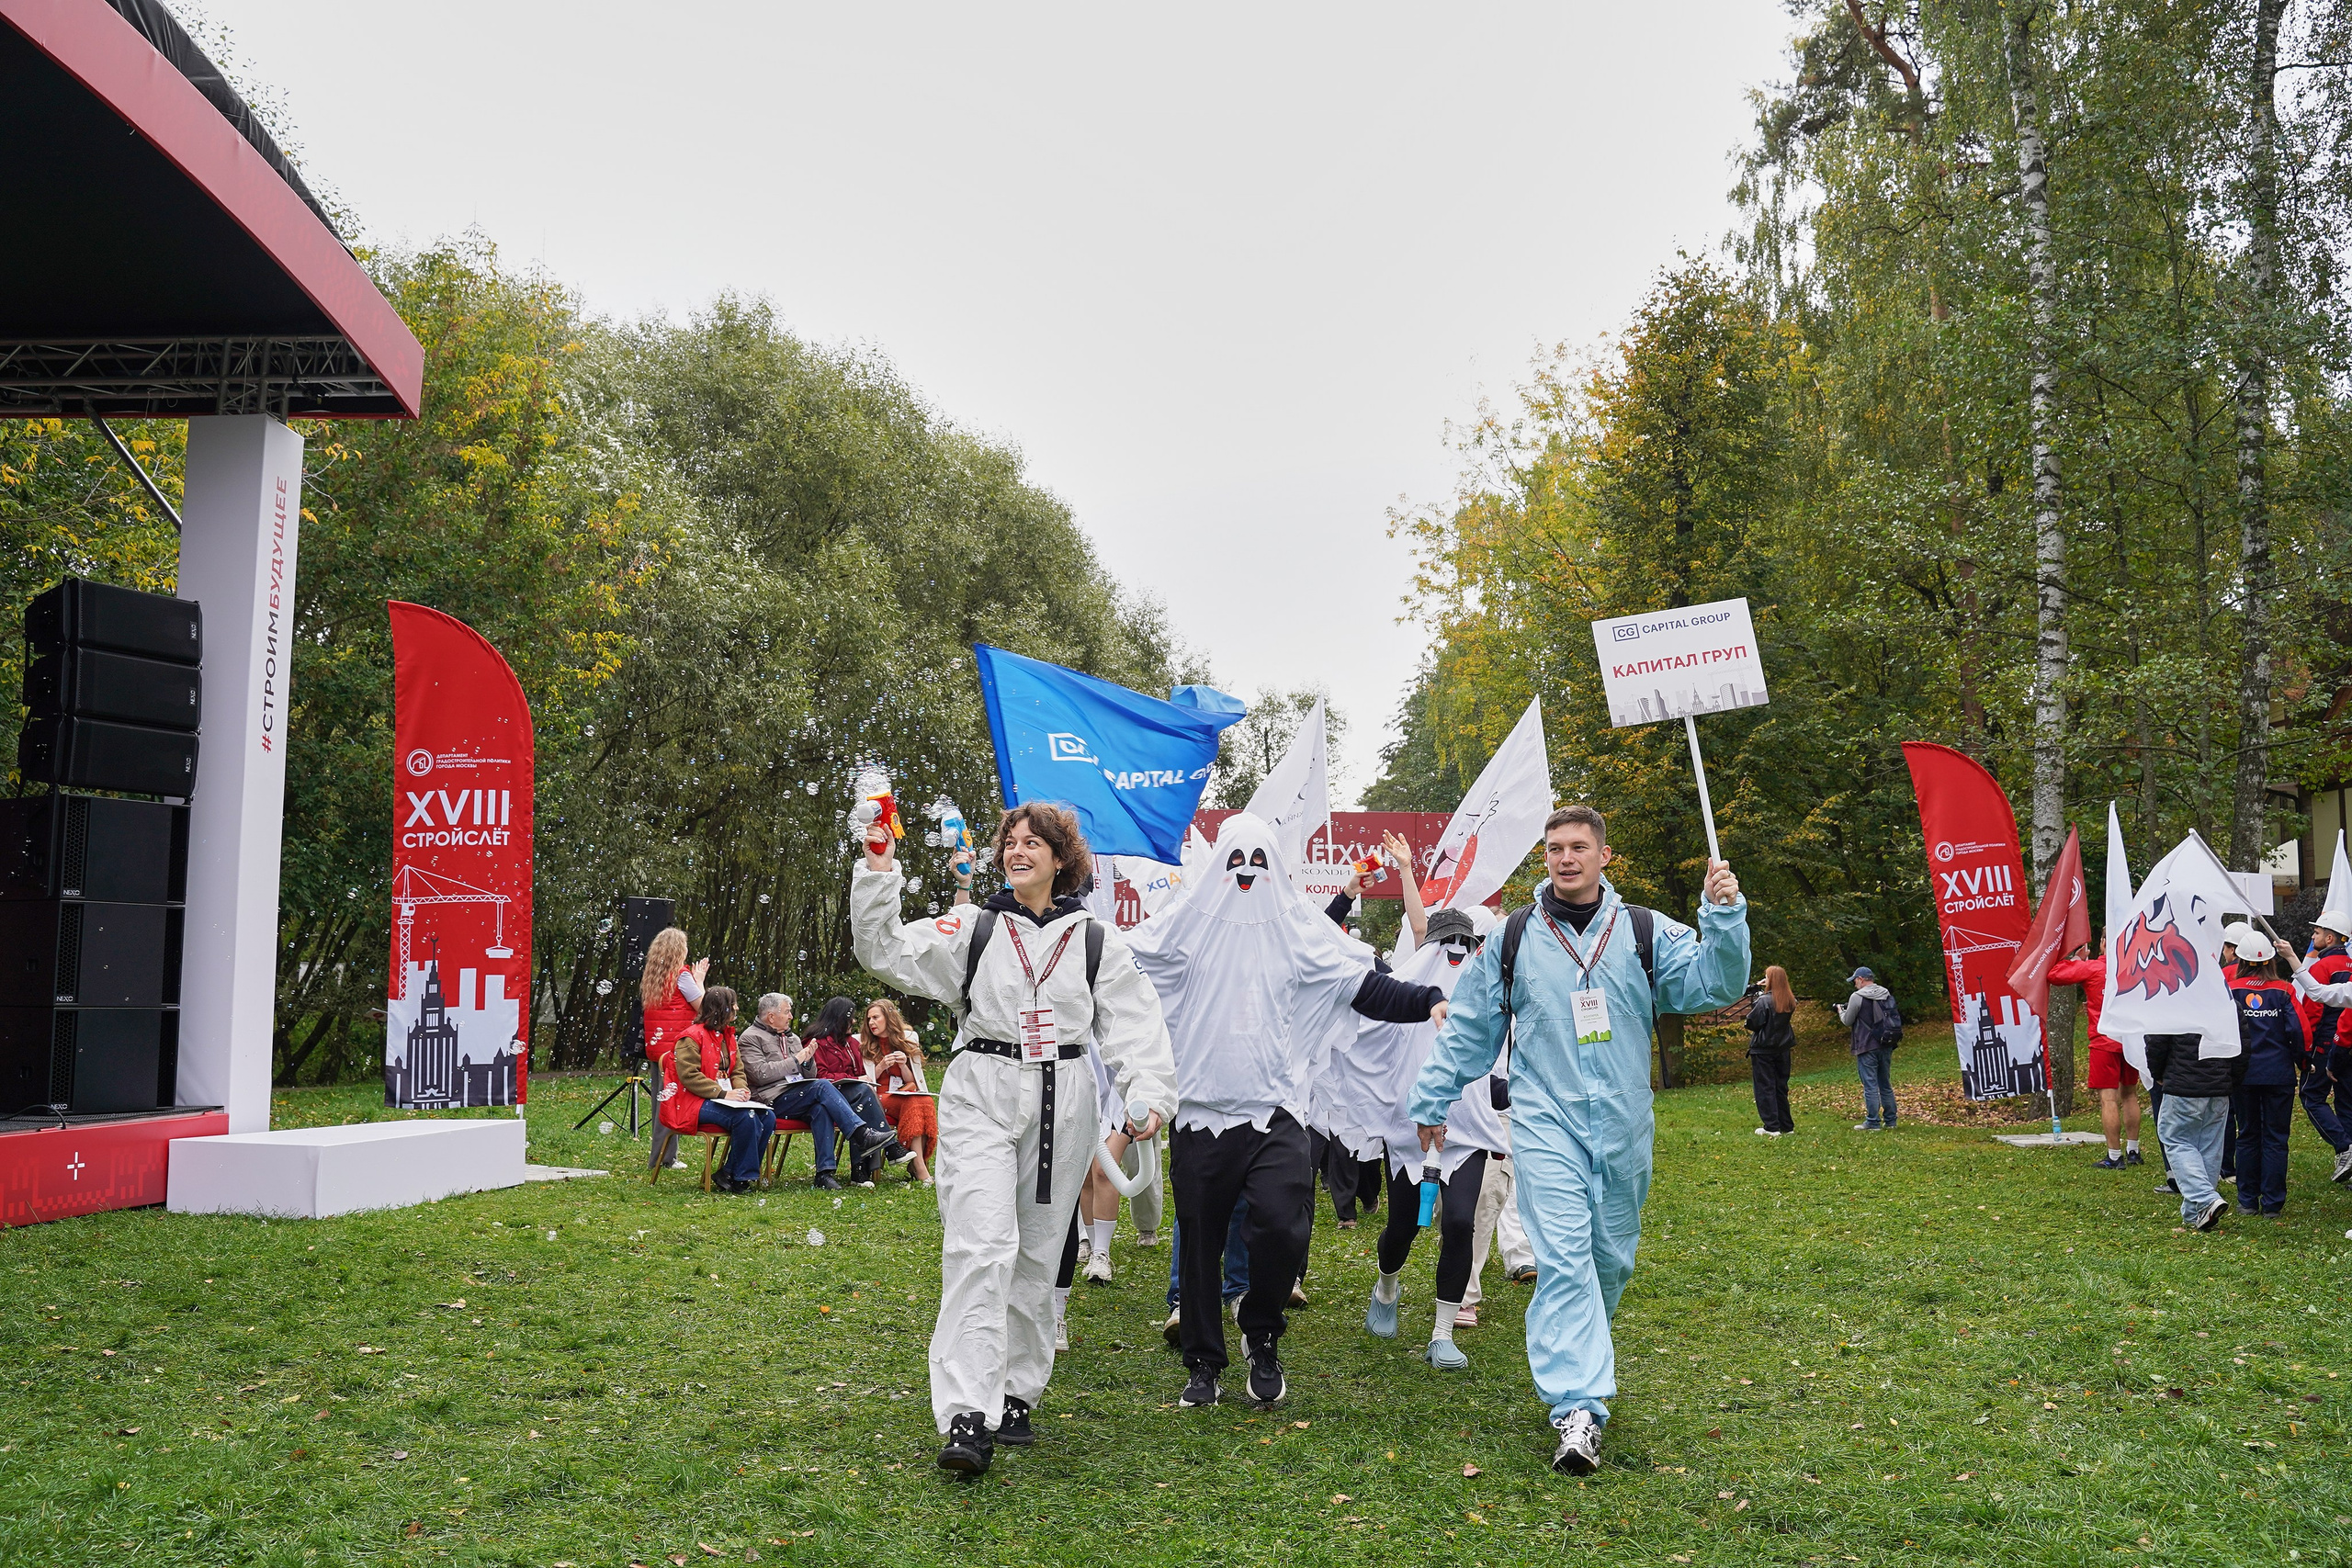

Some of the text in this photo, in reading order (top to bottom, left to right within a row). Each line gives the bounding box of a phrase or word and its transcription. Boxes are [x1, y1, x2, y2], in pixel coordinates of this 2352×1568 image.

[261, 476, 288, 753] #СТРОИМБУДУЩЕЕ
[1617, 612, 1731, 637] CG CAPITAL GROUP
[1612, 645, 1747, 679] КАПИТАЛ ГРУП
[404, 789, 510, 828] XVIII
[402, 828, 510, 848] СТРОЙСЛЁТ
[1939, 864, 2012, 899] XVIII
[1944, 893, 2015, 914] СТРОЙСЛЁТ
